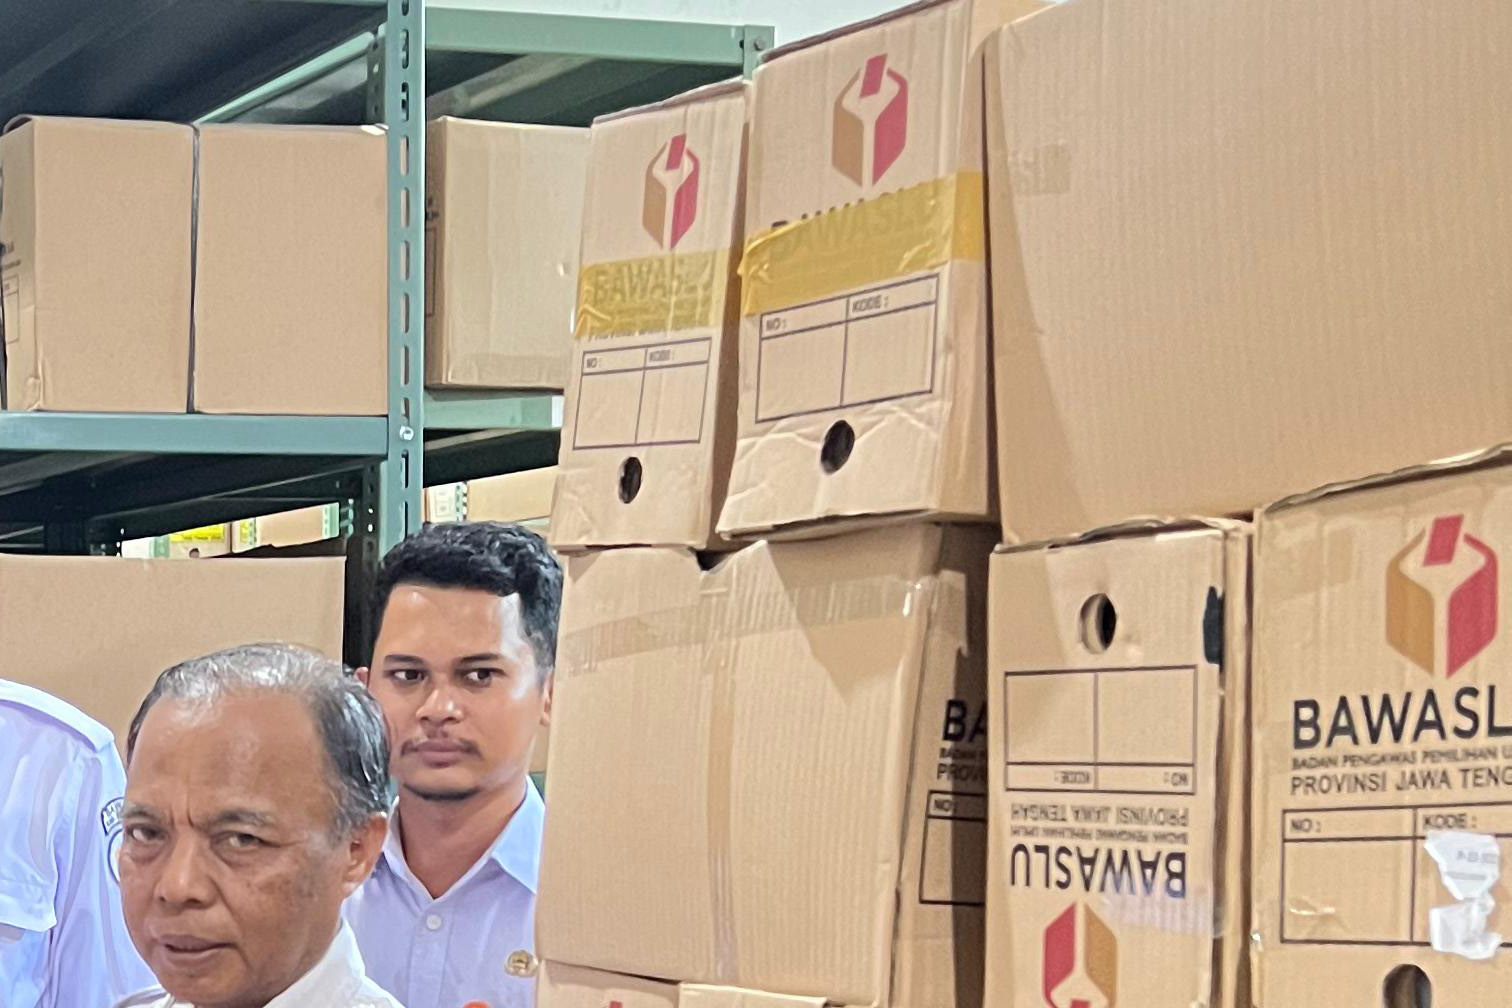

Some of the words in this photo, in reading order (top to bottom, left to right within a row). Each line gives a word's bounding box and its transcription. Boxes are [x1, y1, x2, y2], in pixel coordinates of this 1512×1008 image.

[1291, 772, 1388, 796] PROVINSI
[1396, 768, 1452, 792] JAWA
[1010, 843, 1187, 899] BAWASLU
